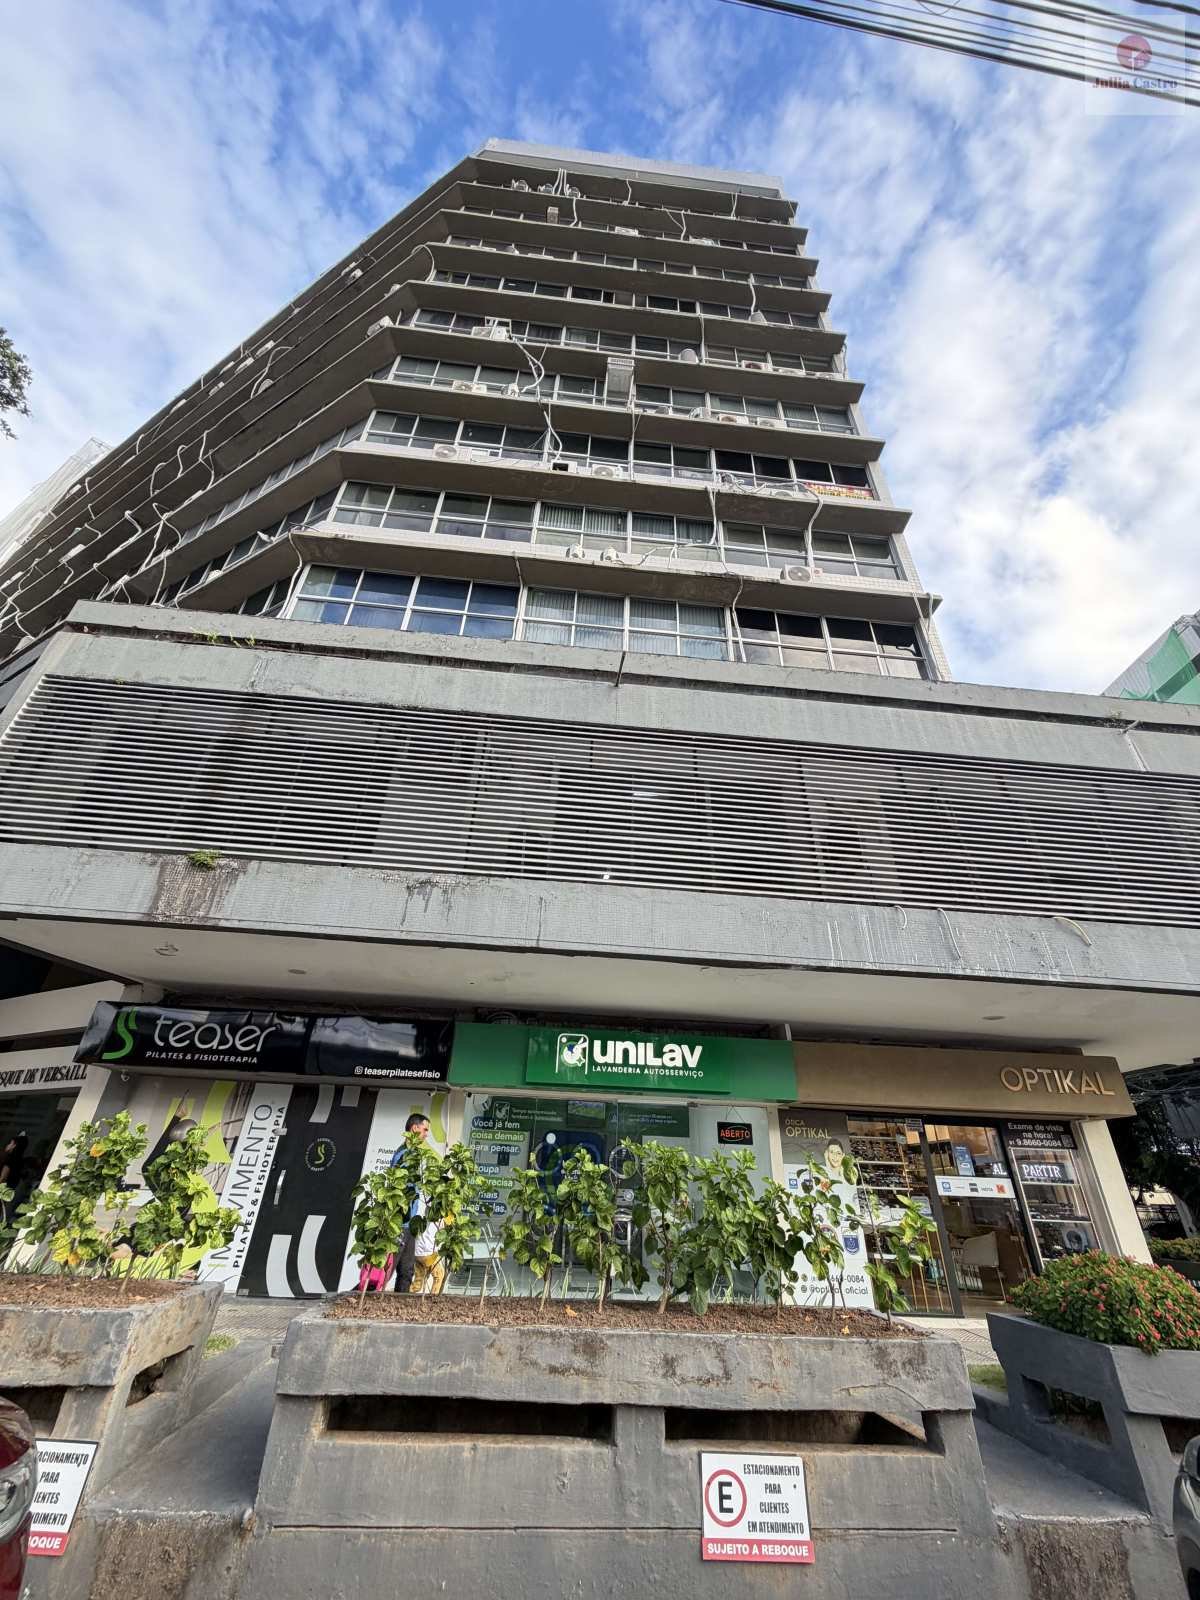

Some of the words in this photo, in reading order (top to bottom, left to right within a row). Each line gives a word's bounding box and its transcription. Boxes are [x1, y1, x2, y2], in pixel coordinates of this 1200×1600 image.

[154, 1014, 276, 1052] teaser
[145, 1051, 183, 1061] PILATES
[185, 1052, 192, 1061] &
[194, 1052, 258, 1064] FISIOTERAPIA
[364, 1067, 441, 1079] teaserpilatesefisio
[592, 1065, 641, 1075] LAVANDERIA
[643, 1067, 704, 1079] AUTOSSERVIÇO
[1000, 1066, 1116, 1096] OPTIKAL
[473, 1118, 494, 1128] Você
[471, 1131, 493, 1140] coisa
[494, 1131, 524, 1141] demais
[720, 1128, 751, 1139] ABERTO
[785, 1126, 832, 1139] OPTIKAL
[478, 1164, 500, 1174] oupa
[210, 1104, 273, 1260] MVIMENTO
[232, 1210, 255, 1268] PILATES
[254, 1106, 286, 1194] FISIOTERAPIA
[743, 1464, 800, 1476] ESTACIONAMENTO
[39, 1471, 61, 1484] PARA
[764, 1483, 782, 1494] PARA
[717, 1481, 734, 1514] E
[759, 1502, 790, 1514] CLIENTES
[747, 1521, 758, 1533] EM
[759, 1522, 805, 1534] ATENDIMENTO
[707, 1543, 750, 1555] SUJEITO
[752, 1545, 760, 1555] A
[761, 1545, 809, 1556] REBOQUE
